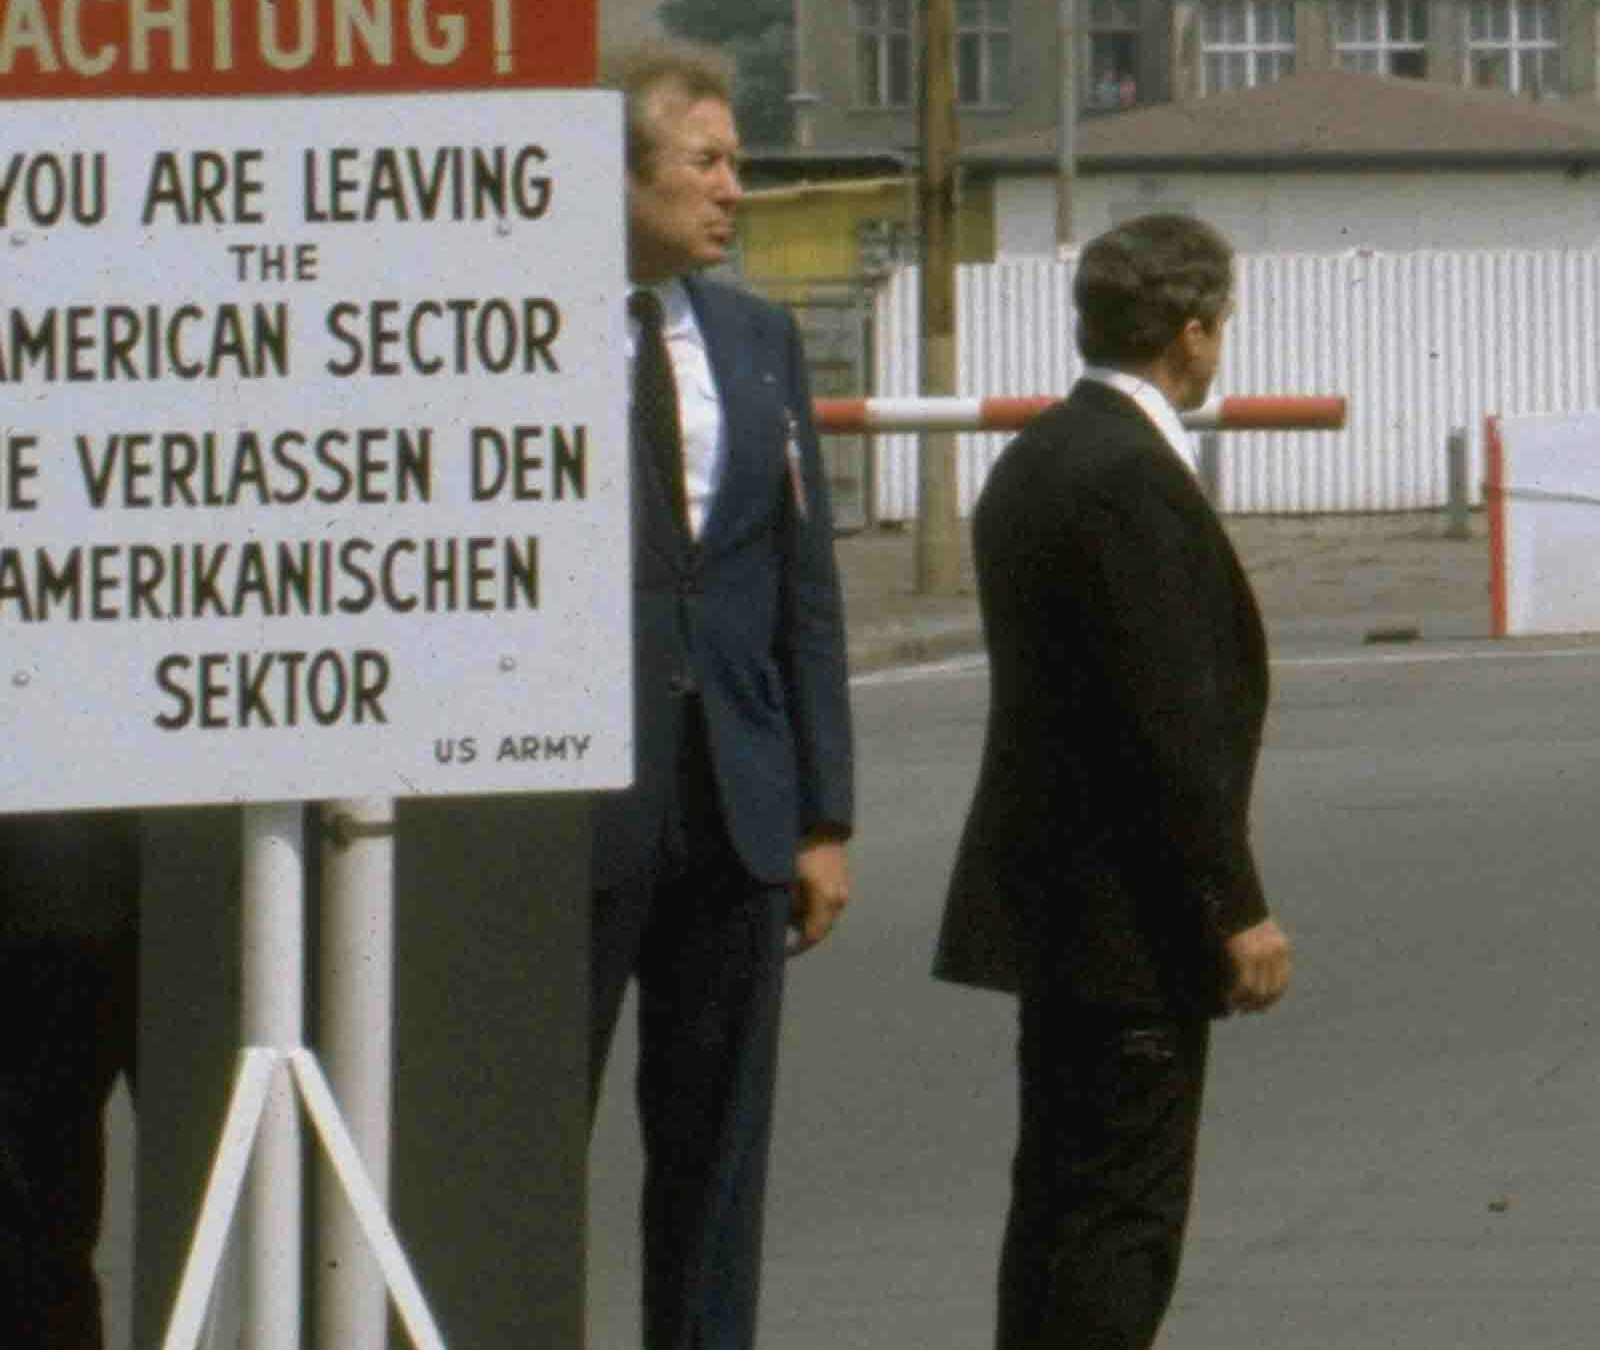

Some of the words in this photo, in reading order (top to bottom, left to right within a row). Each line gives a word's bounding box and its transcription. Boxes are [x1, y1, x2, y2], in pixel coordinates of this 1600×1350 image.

[142, 150, 262, 225] ARE
[305, 146, 551, 222] LEAVING
[230, 244, 318, 282] THE
[0, 303, 288, 382] MERICAN
[326, 298, 560, 377] SECTOR
[76, 429, 432, 508] VERLASSEN
[471, 426, 585, 502] DEN
[0, 537, 538, 622] AMERIKANISCHEN
[155, 650, 390, 730] SEKTOR
[435, 737, 478, 765] US
[497, 735, 591, 762] ARMY
